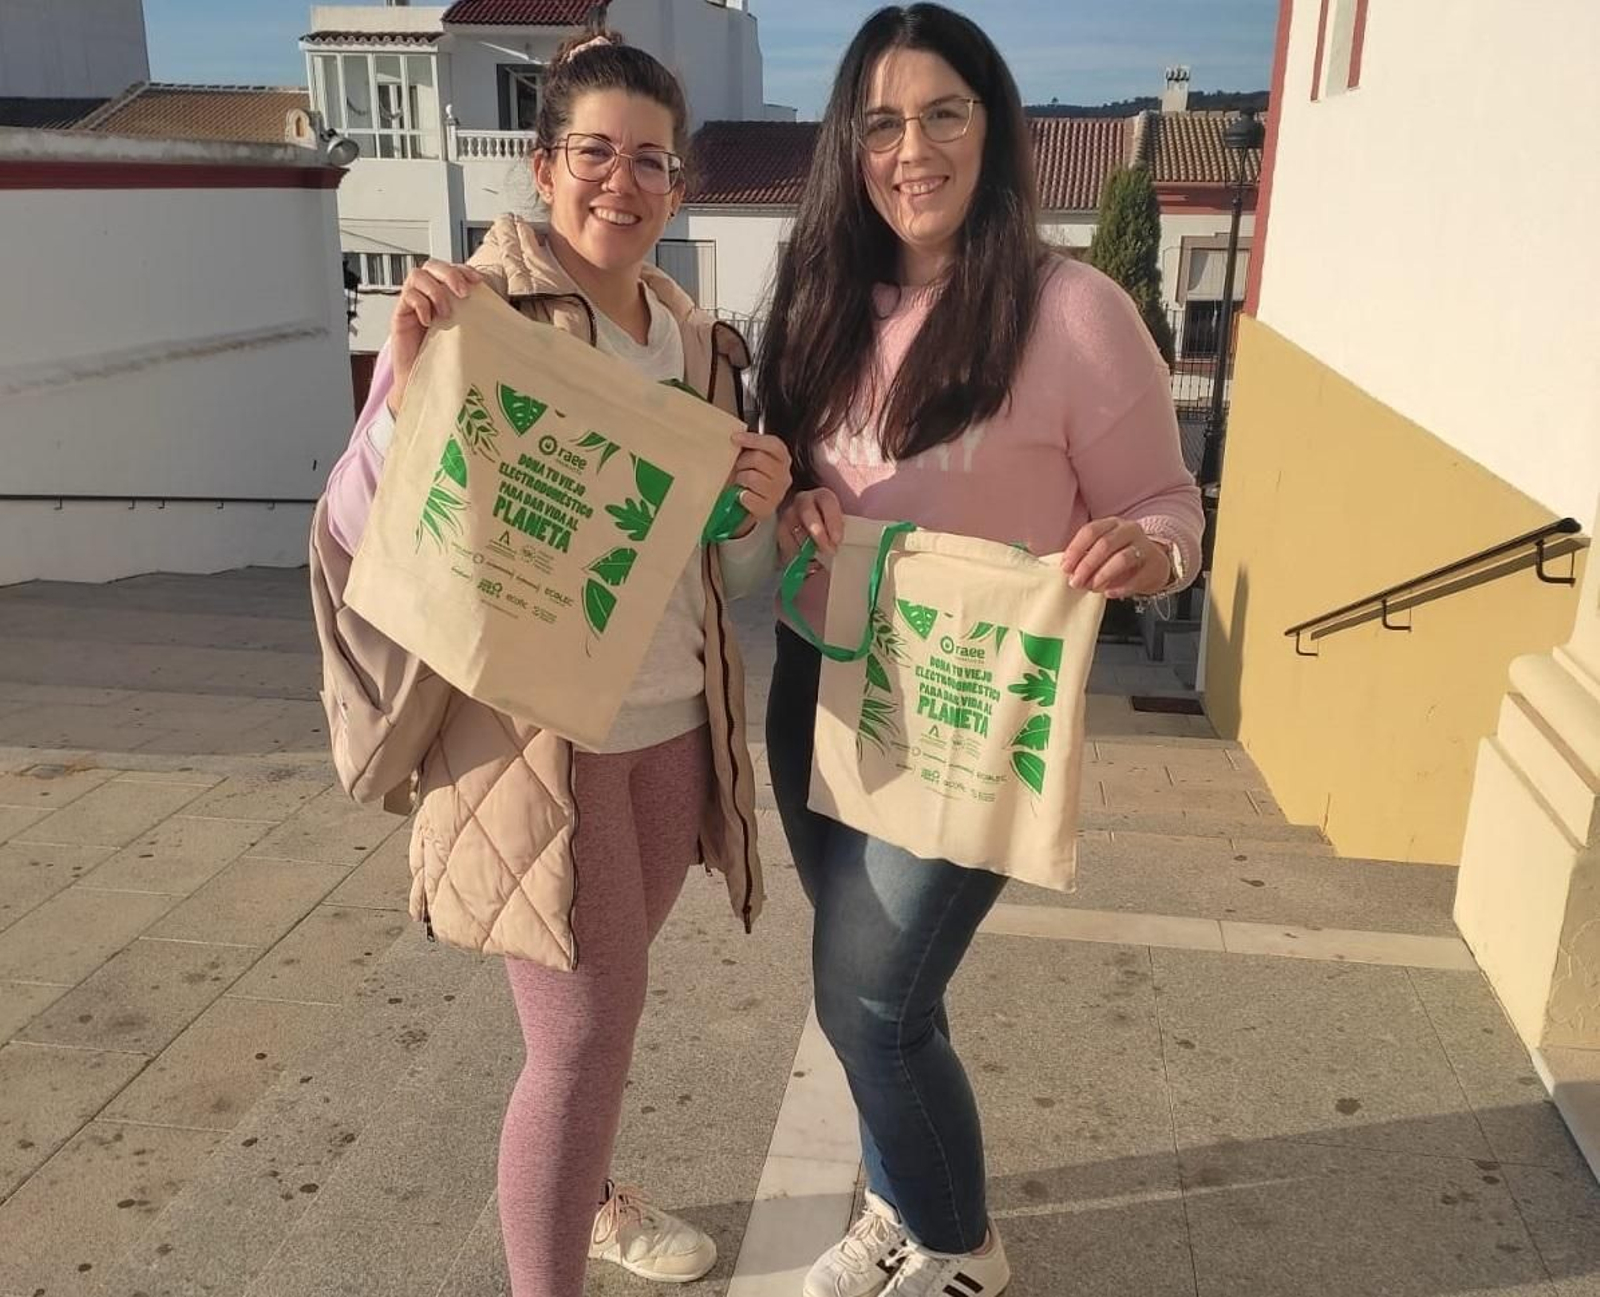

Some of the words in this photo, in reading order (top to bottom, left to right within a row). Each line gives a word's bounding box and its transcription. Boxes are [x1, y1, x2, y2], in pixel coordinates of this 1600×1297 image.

[518, 453, 546, 476] DONA
[545, 466, 560, 482] TU
[558, 474, 586, 497] VIEJO
[493, 494, 571, 553] PLANETA
[499, 481, 523, 503] PARA
[523, 492, 545, 513] DAR
[544, 503, 567, 524] VIDA
[566, 516, 579, 532] AL
[930, 655, 951, 674] DONA
[952, 665, 963, 678] TU
[964, 667, 993, 682] VIEJO
[917, 695, 989, 739] PLANETA
[919, 682, 942, 700] PARA
[943, 690, 960, 706] DAR
[960, 695, 983, 711] VIDA
[983, 702, 992, 715] AL
